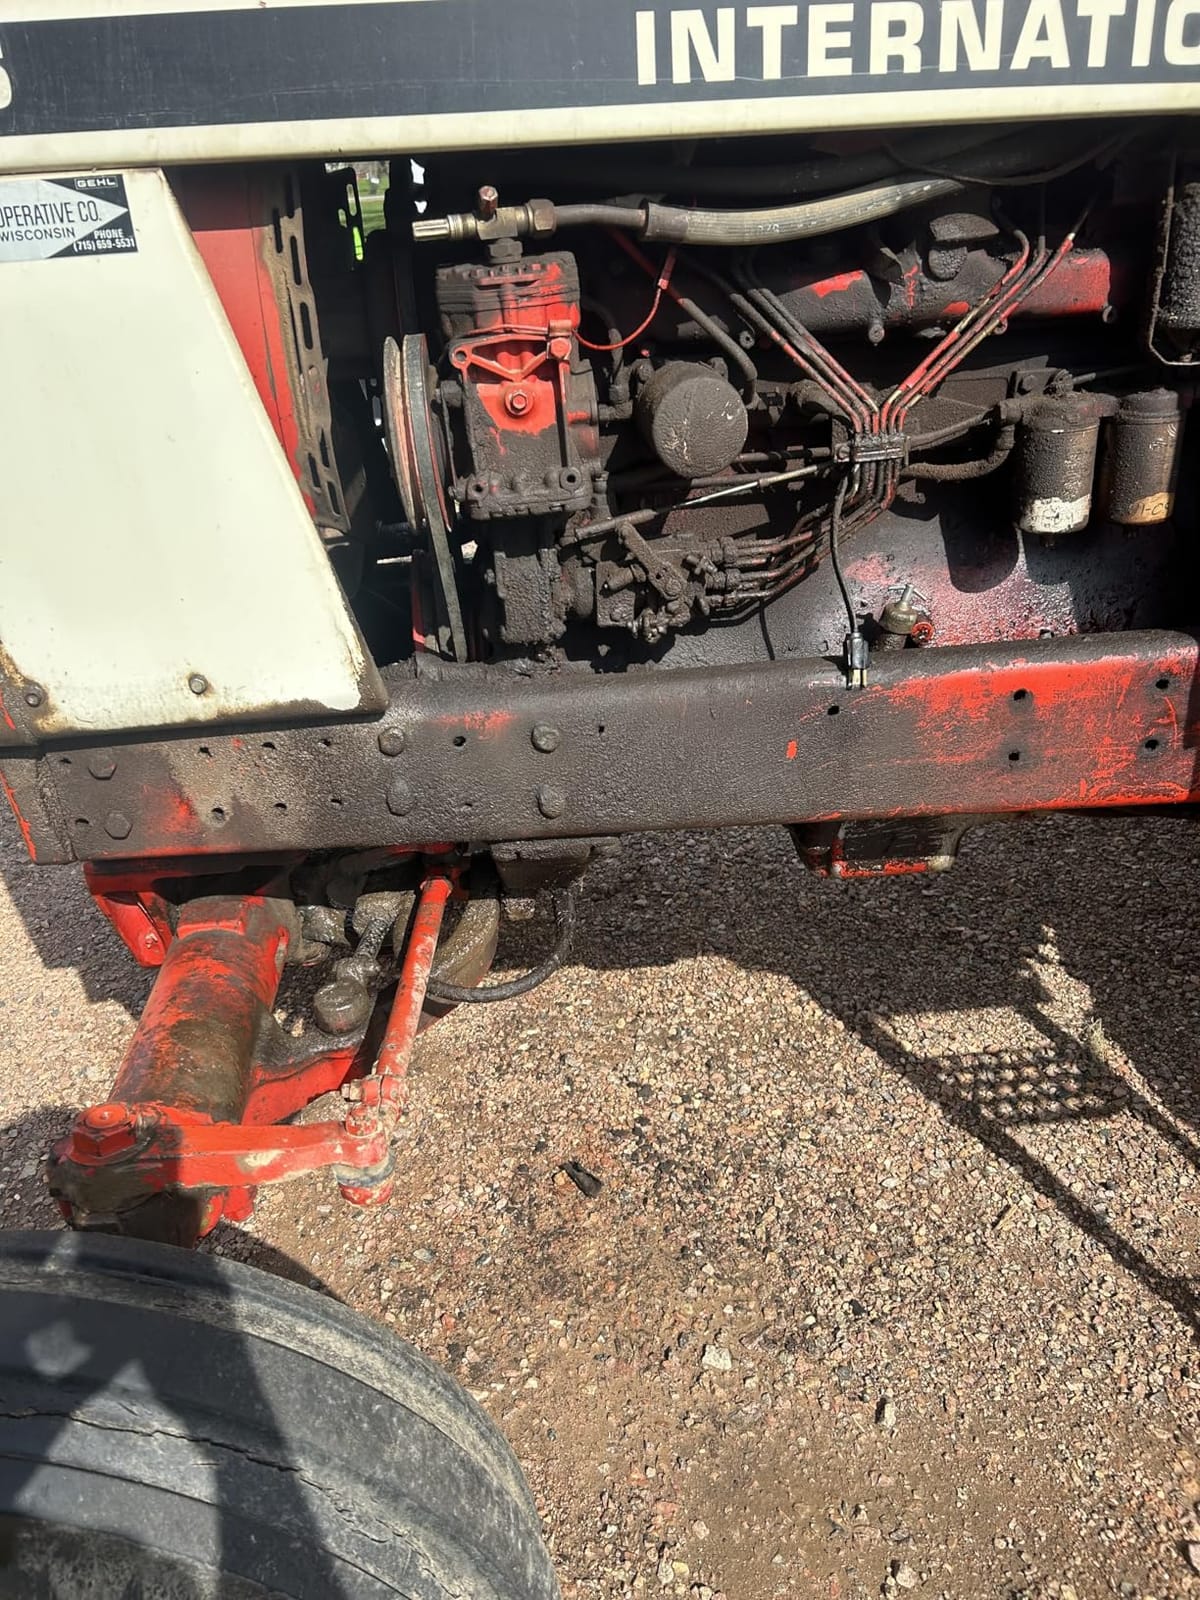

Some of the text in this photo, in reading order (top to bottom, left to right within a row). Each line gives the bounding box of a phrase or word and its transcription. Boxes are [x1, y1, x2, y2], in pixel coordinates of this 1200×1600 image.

[636, 0, 1200, 86] INTERNATIO
[77, 178, 116, 188] GEHL
[77, 200, 103, 222] CO.
[0, 227, 76, 242] WISCONSIN
[93, 228, 125, 239] PHONE
[73, 240, 96, 252] (715)
